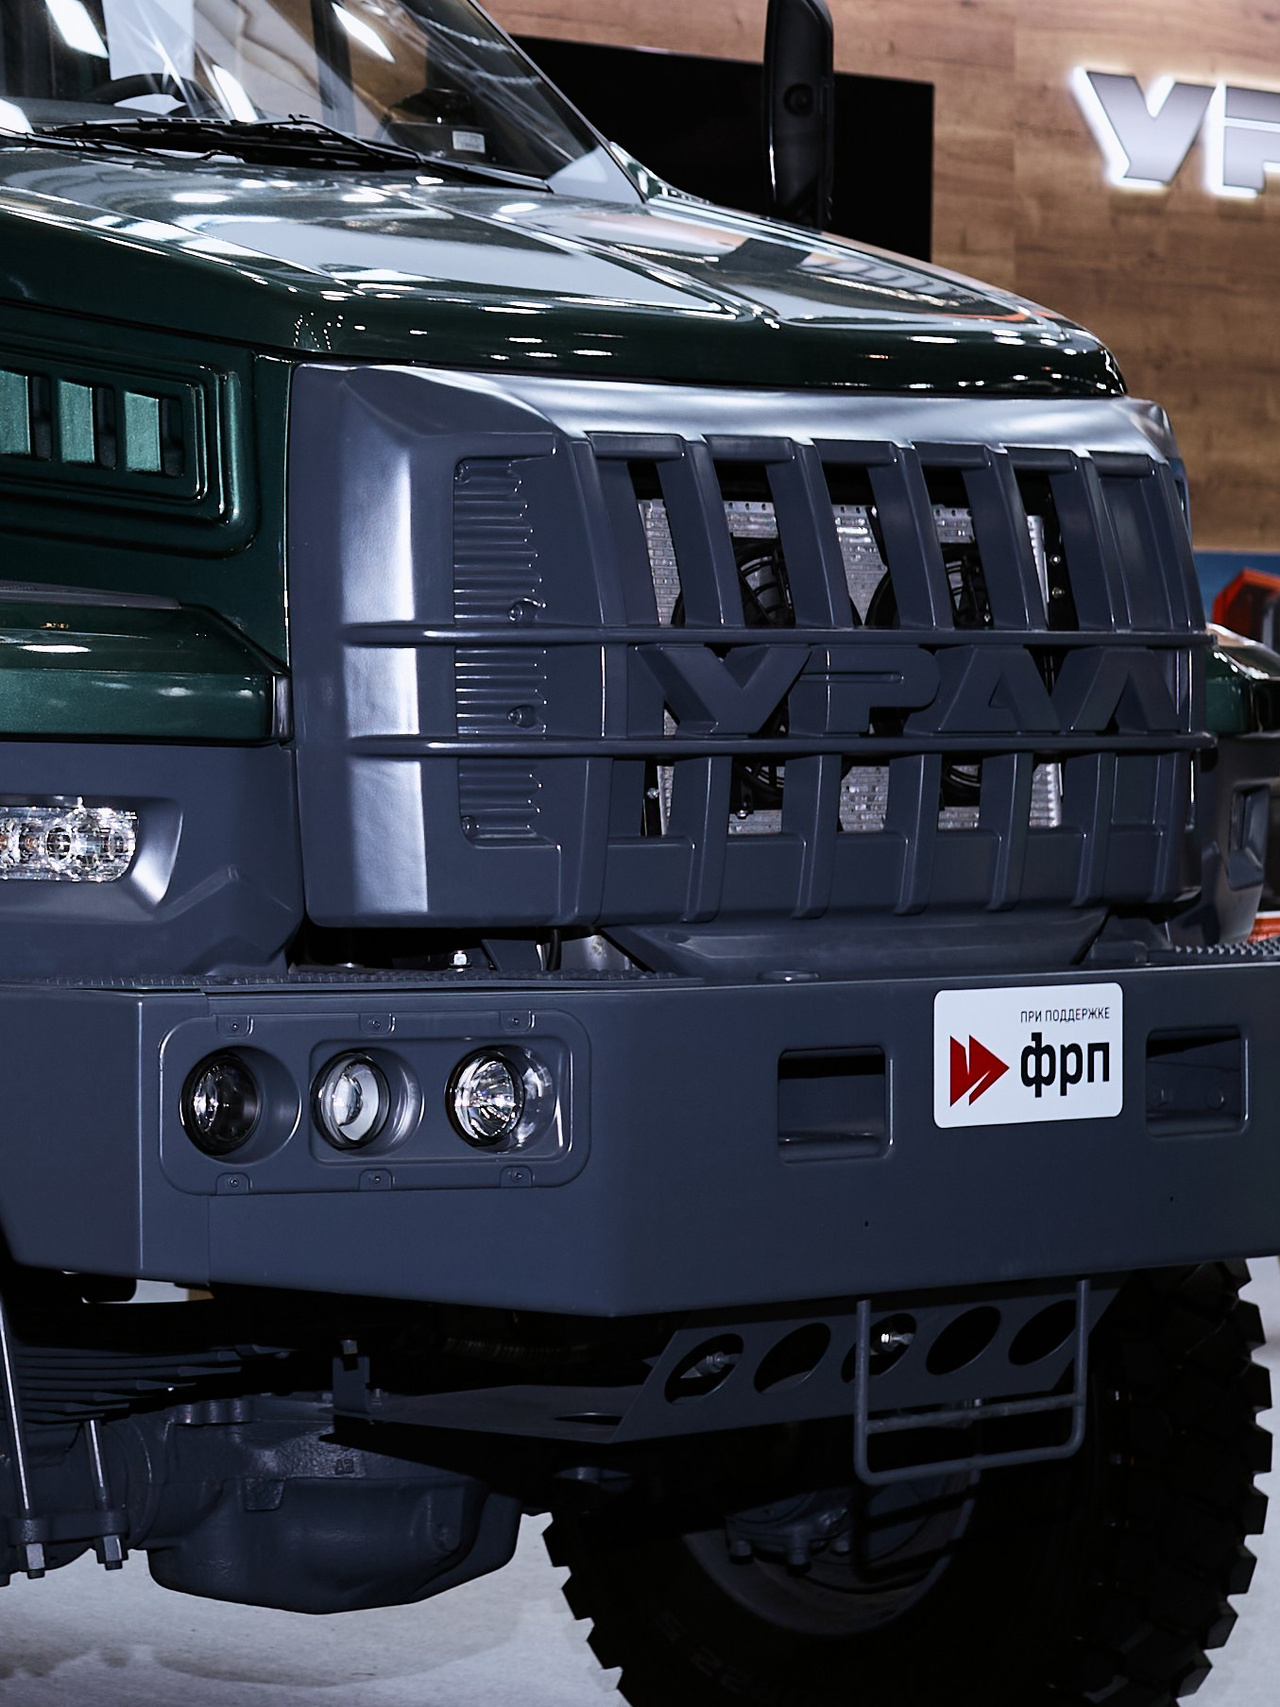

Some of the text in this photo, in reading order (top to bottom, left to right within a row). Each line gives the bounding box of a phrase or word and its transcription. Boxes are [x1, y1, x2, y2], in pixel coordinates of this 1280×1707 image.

[635, 643, 1186, 735] УРАЛ
[1020, 1006, 1110, 1023] ПРИ ПОДДЕРЖКЕ
